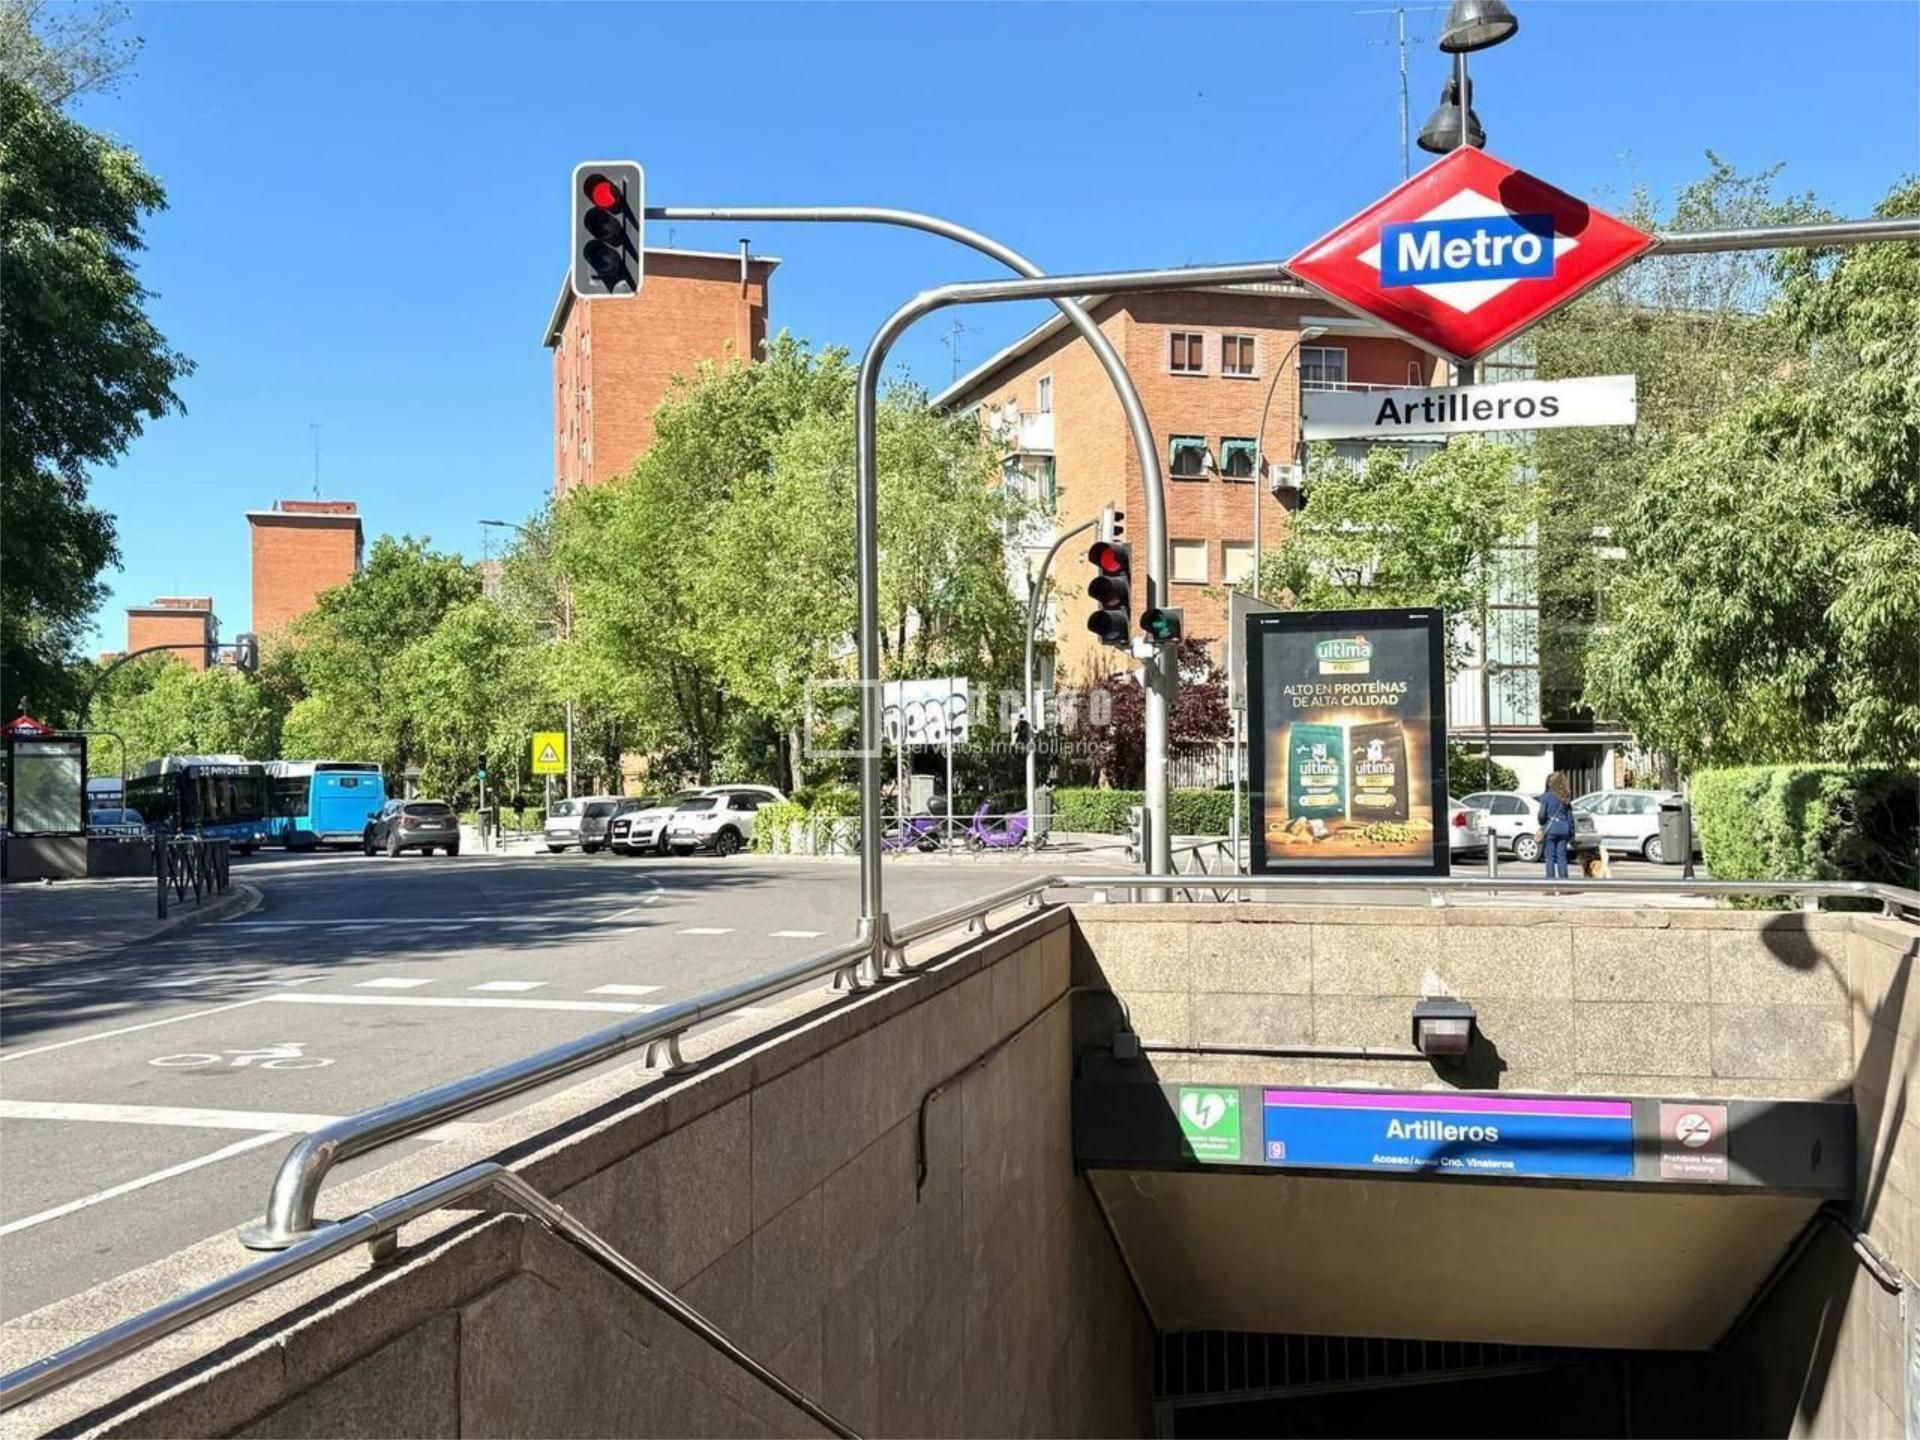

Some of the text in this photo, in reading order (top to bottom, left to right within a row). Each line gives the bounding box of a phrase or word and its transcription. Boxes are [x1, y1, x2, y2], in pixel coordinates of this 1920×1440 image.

[1398, 229, 1543, 272] Metro
[1375, 393, 1560, 426] Artilleros
[1318, 642, 1371, 658] ultima
[1283, 680, 1408, 696] ALTO EN PROTEÍNAS
[1292, 693, 1399, 708] DE ALTA CALIDAD
[1386, 1118, 1499, 1142] Artilleros
